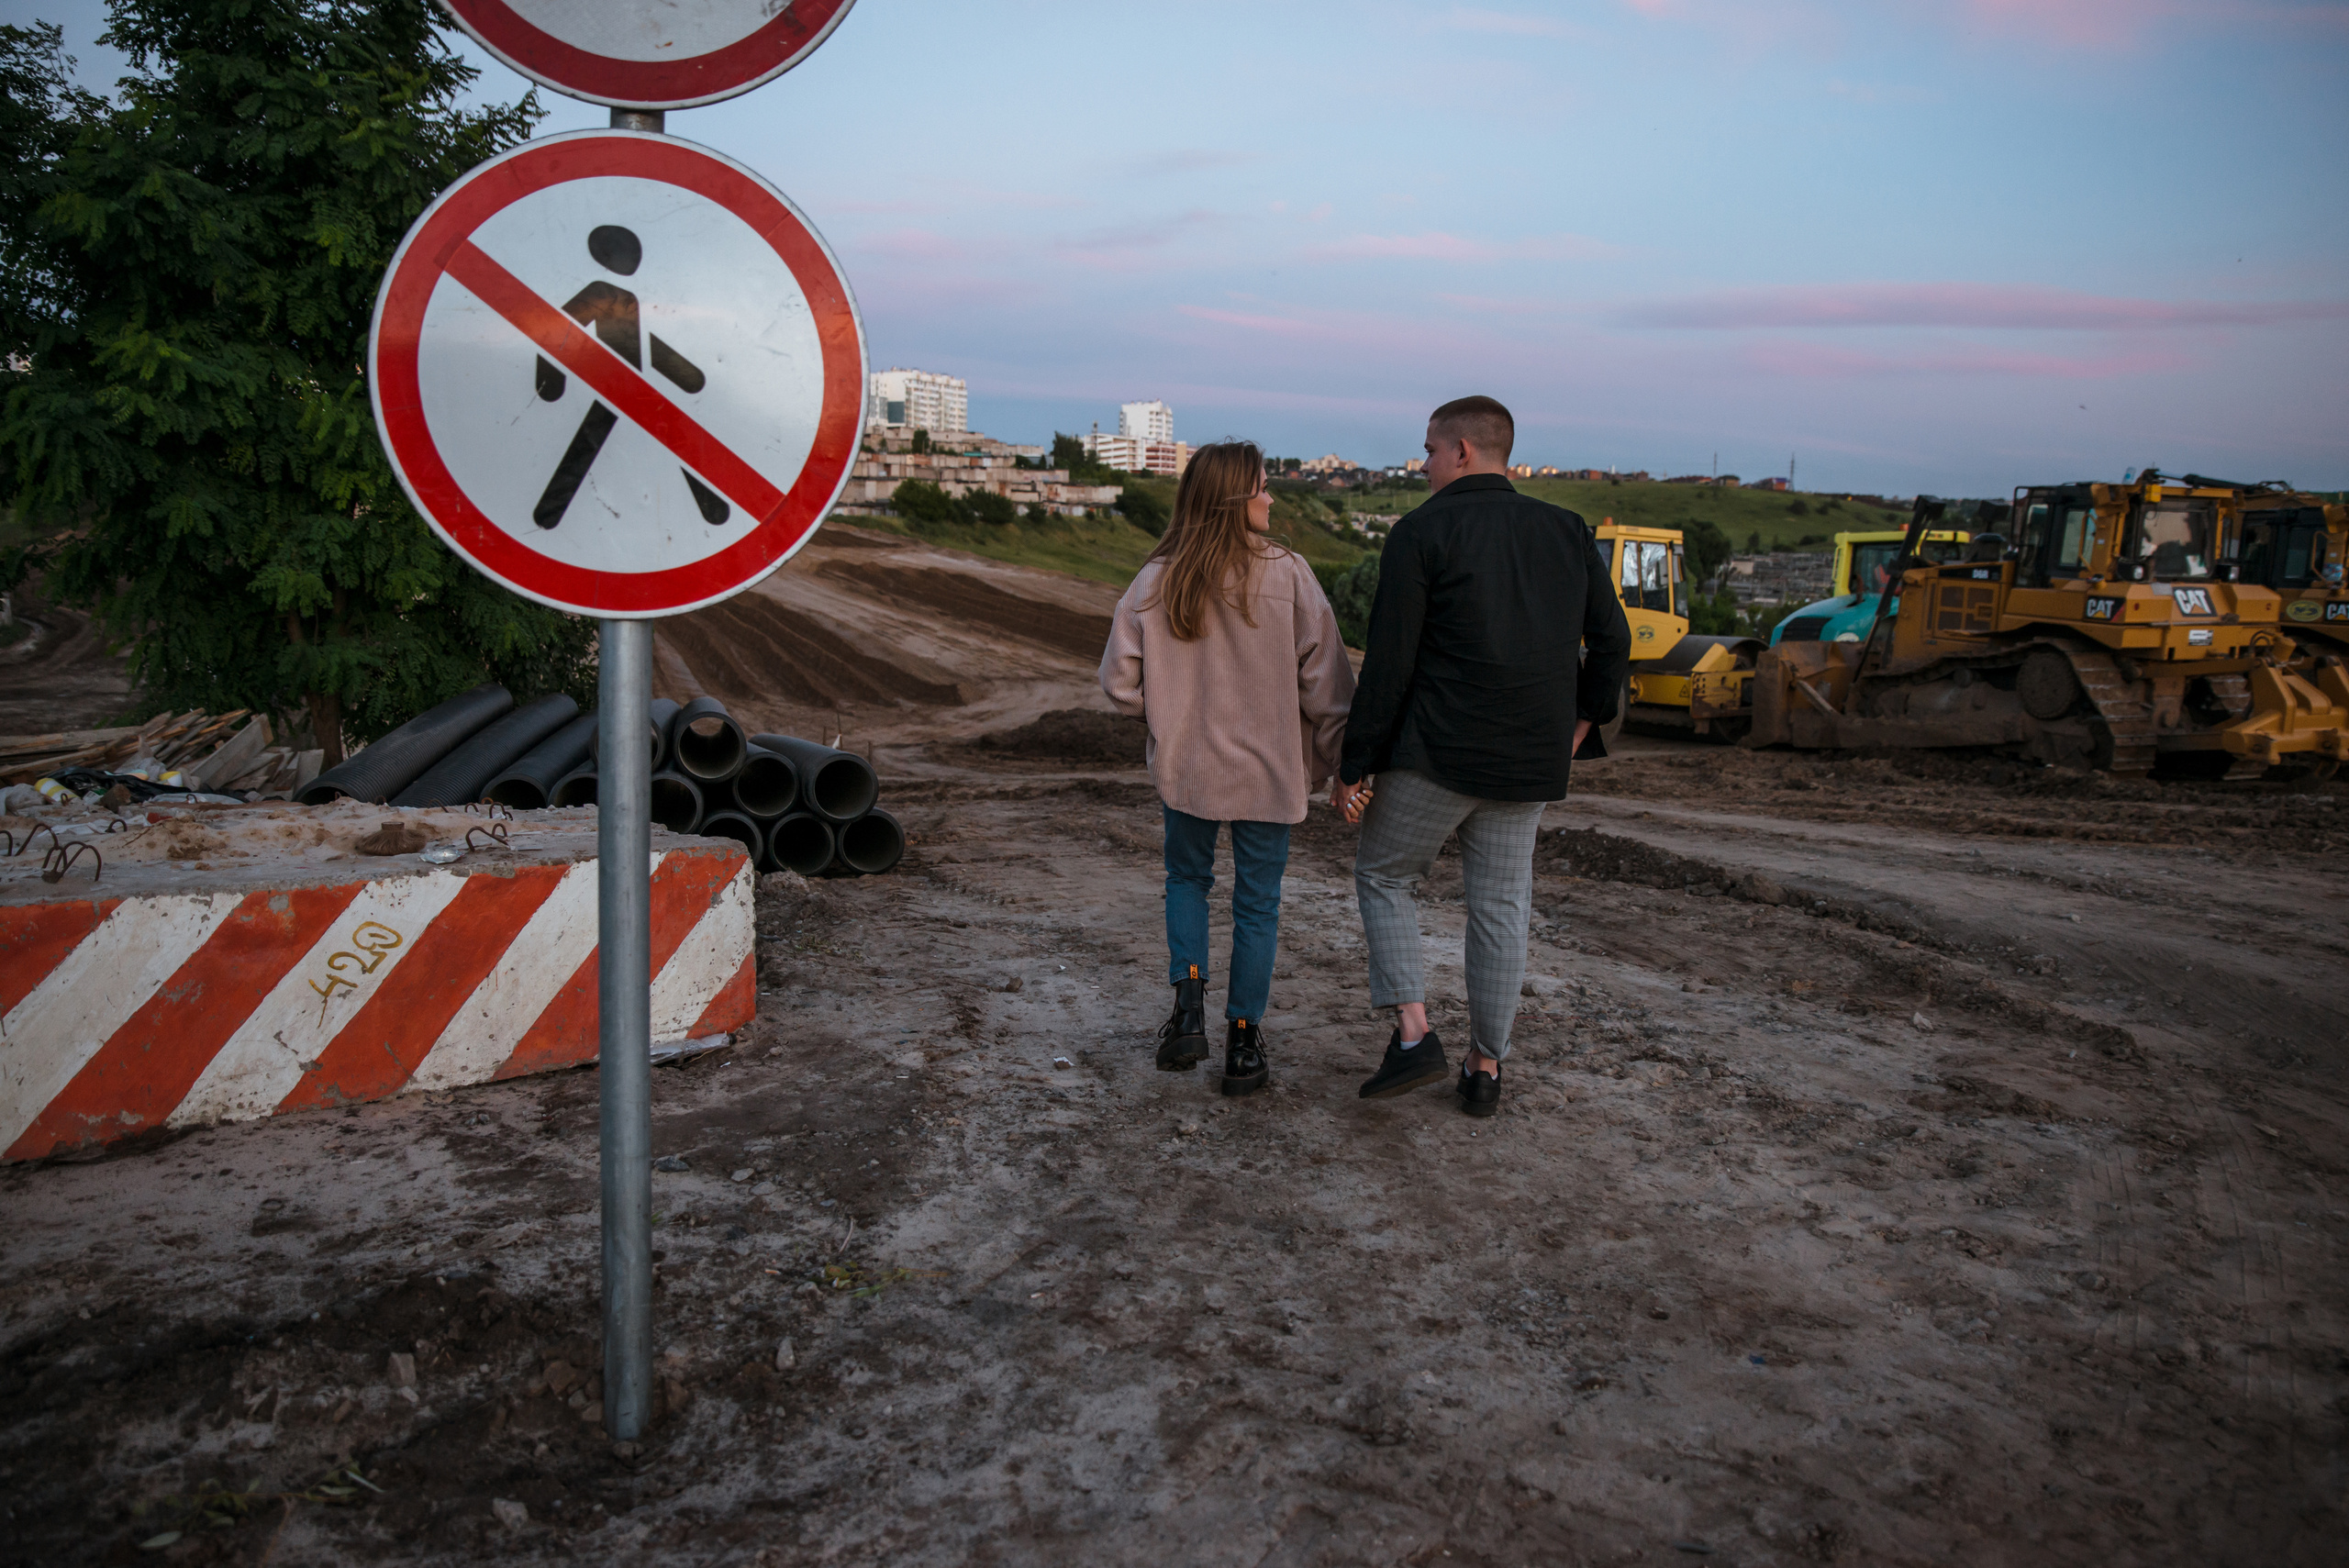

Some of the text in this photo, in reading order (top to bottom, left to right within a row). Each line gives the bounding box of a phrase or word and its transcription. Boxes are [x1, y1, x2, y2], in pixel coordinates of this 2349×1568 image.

[2086, 598, 2115, 619] CAT
[2174, 588, 2212, 615] CAT
[308, 920, 404, 1004] 420
